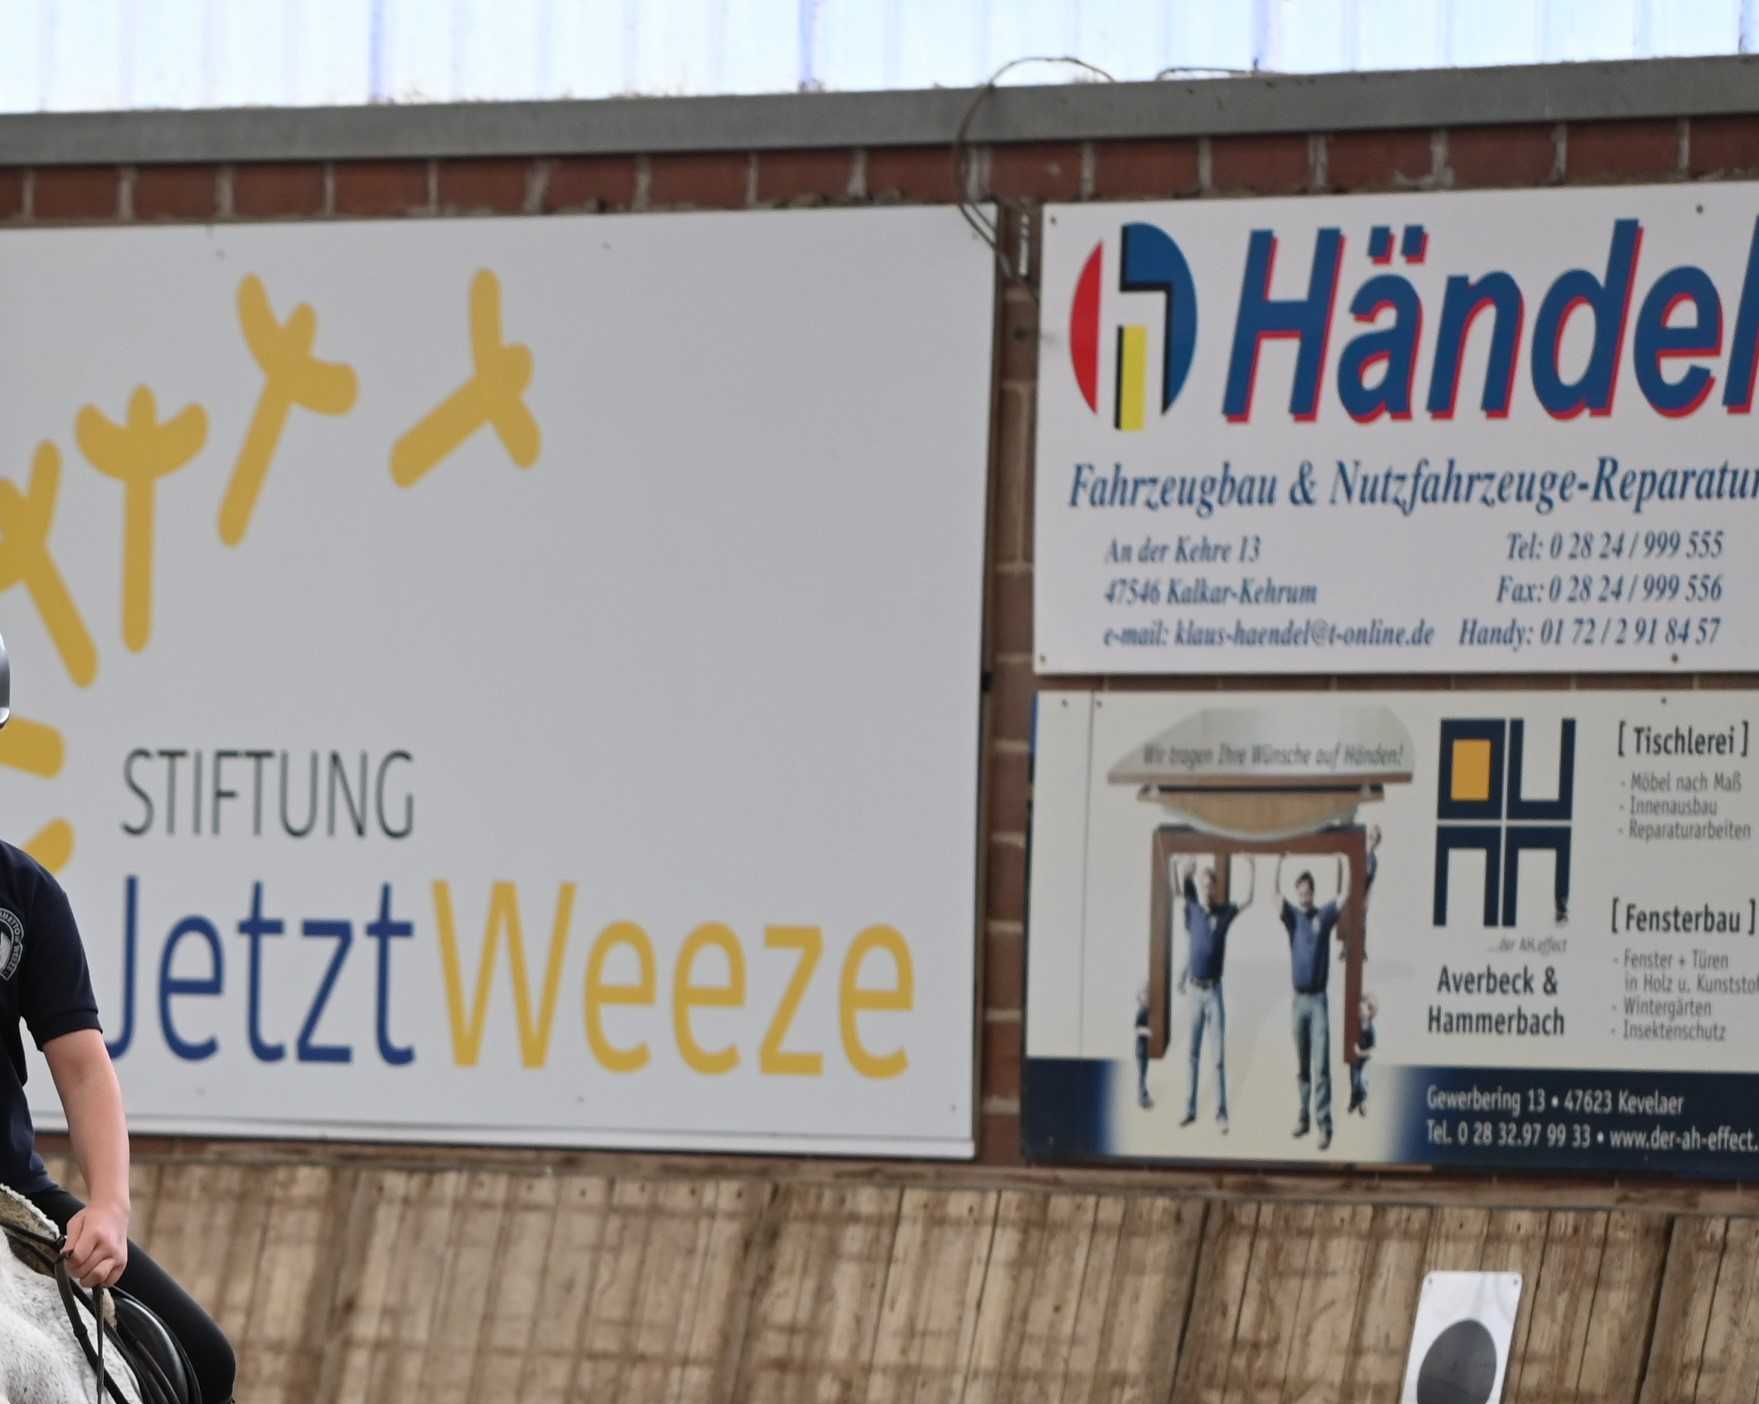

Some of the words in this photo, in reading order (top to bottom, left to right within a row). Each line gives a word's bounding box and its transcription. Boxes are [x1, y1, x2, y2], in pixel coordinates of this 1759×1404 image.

[1222, 213, 1759, 424] Händel
[1069, 461, 1278, 519] Fahrzeugbau
[1289, 460, 1317, 508] &
[1106, 537, 1132, 564] An
[1138, 536, 1170, 562] der
[1175, 535, 1232, 563] Kehre
[1238, 534, 1261, 563] 13
[1506, 532, 1542, 560] Tel:
[1644, 531, 1681, 558] 999
[1687, 531, 1724, 558] 555
[1105, 577, 1160, 605] 47546
[1167, 576, 1317, 605] Kalkar-Kehrum
[1496, 575, 1542, 604] Fax:
[1643, 574, 1680, 601] 999
[1685, 574, 1723, 601] 556
[1103, 619, 1167, 646] e-mail:
[1174, 618, 1435, 647] klaus-haendel@t-online.de
[1458, 618, 1534, 651] Handy:
[1540, 618, 1564, 645] 01
[1572, 618, 1596, 645] 72
[1634, 725, 1735, 755] Tischlerei
[120, 747, 415, 841] STIFTUNG
[1631, 771, 1671, 792] Möbel
[1676, 771, 1708, 792] nach
[1713, 771, 1742, 792] Maß
[1630, 795, 1718, 816] Innenausbau
[1629, 818, 1752, 843] Reparaturarbeiten
[1625, 902, 1740, 933] Fensterbau
[1624, 948, 1672, 968] Fenster
[1693, 948, 1729, 968] Türen
[1437, 964, 1534, 995] Averbeck
[1543, 966, 1558, 995] &
[1625, 972, 1638, 992] in
[1643, 972, 1672, 992] Holz
[1427, 1005, 1565, 1036] Hammerbach
[1624, 996, 1712, 1020] Wintergärten
[1624, 1019, 1726, 1041] Insektenschutz
[1427, 1085, 1521, 1117] Gewerbering
[1528, 1089, 1546, 1112] 13
[1564, 1089, 1613, 1114] 47623
[1618, 1090, 1684, 1115] Kevelaer
[1427, 1120, 1452, 1144] Tel.
